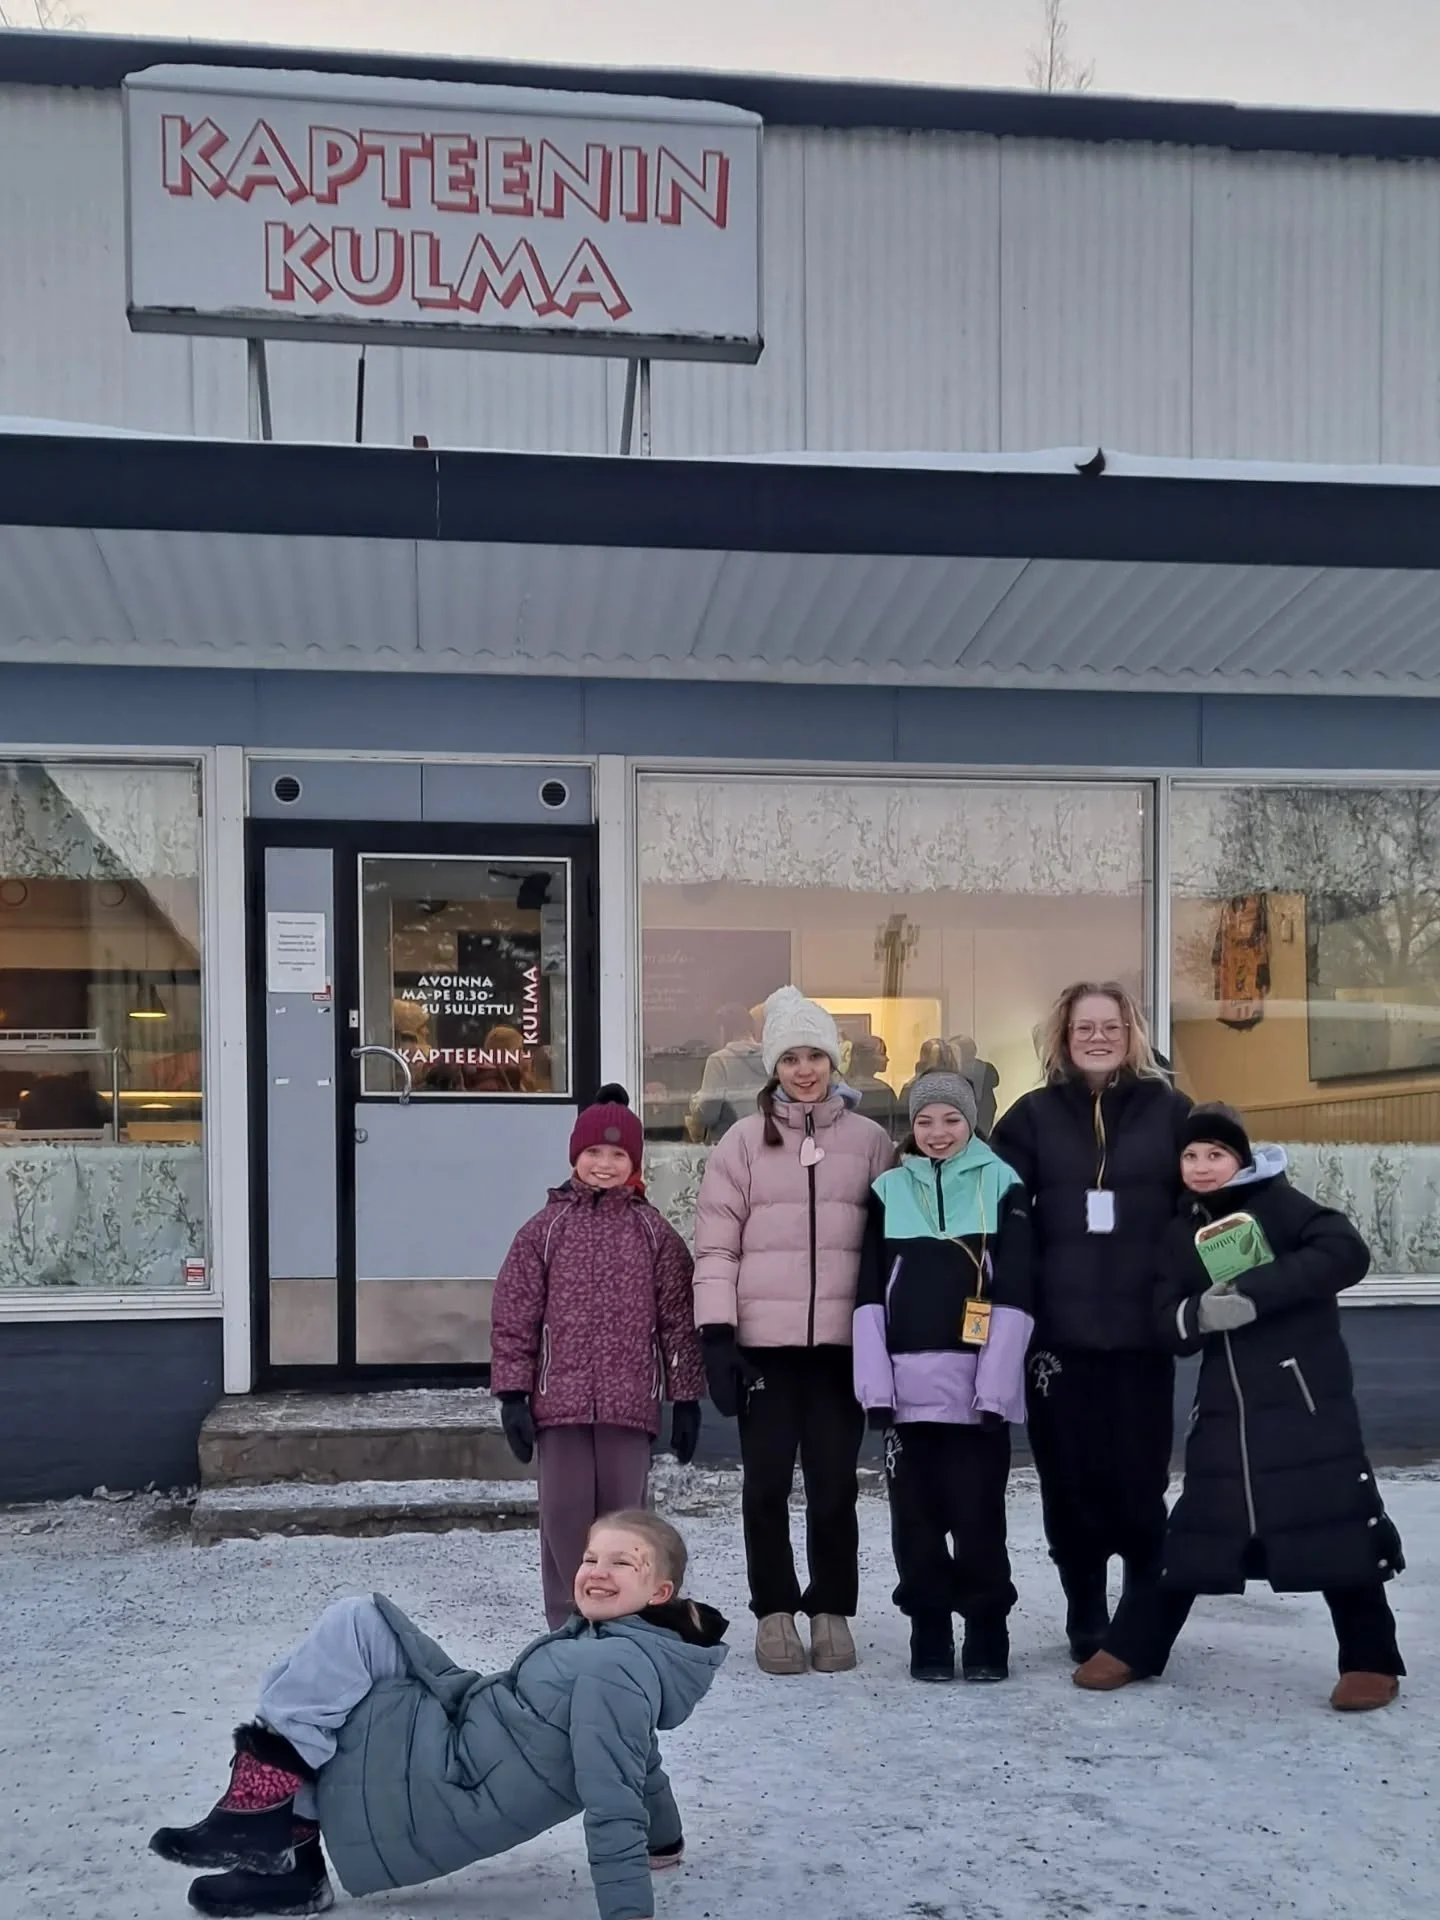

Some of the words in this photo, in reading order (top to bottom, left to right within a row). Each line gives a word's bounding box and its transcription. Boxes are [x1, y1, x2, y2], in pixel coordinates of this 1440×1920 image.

[161, 113, 731, 230] KAPTEENIN
[263, 220, 633, 320] KULMA
[417, 975, 494, 988] AVOINNA
[401, 989, 451, 1001] MA-PE
[444, 1003, 515, 1016] SULJETTU
[522, 966, 539, 1045] KULMA
[397, 1047, 521, 1065] KAPTEENIN
